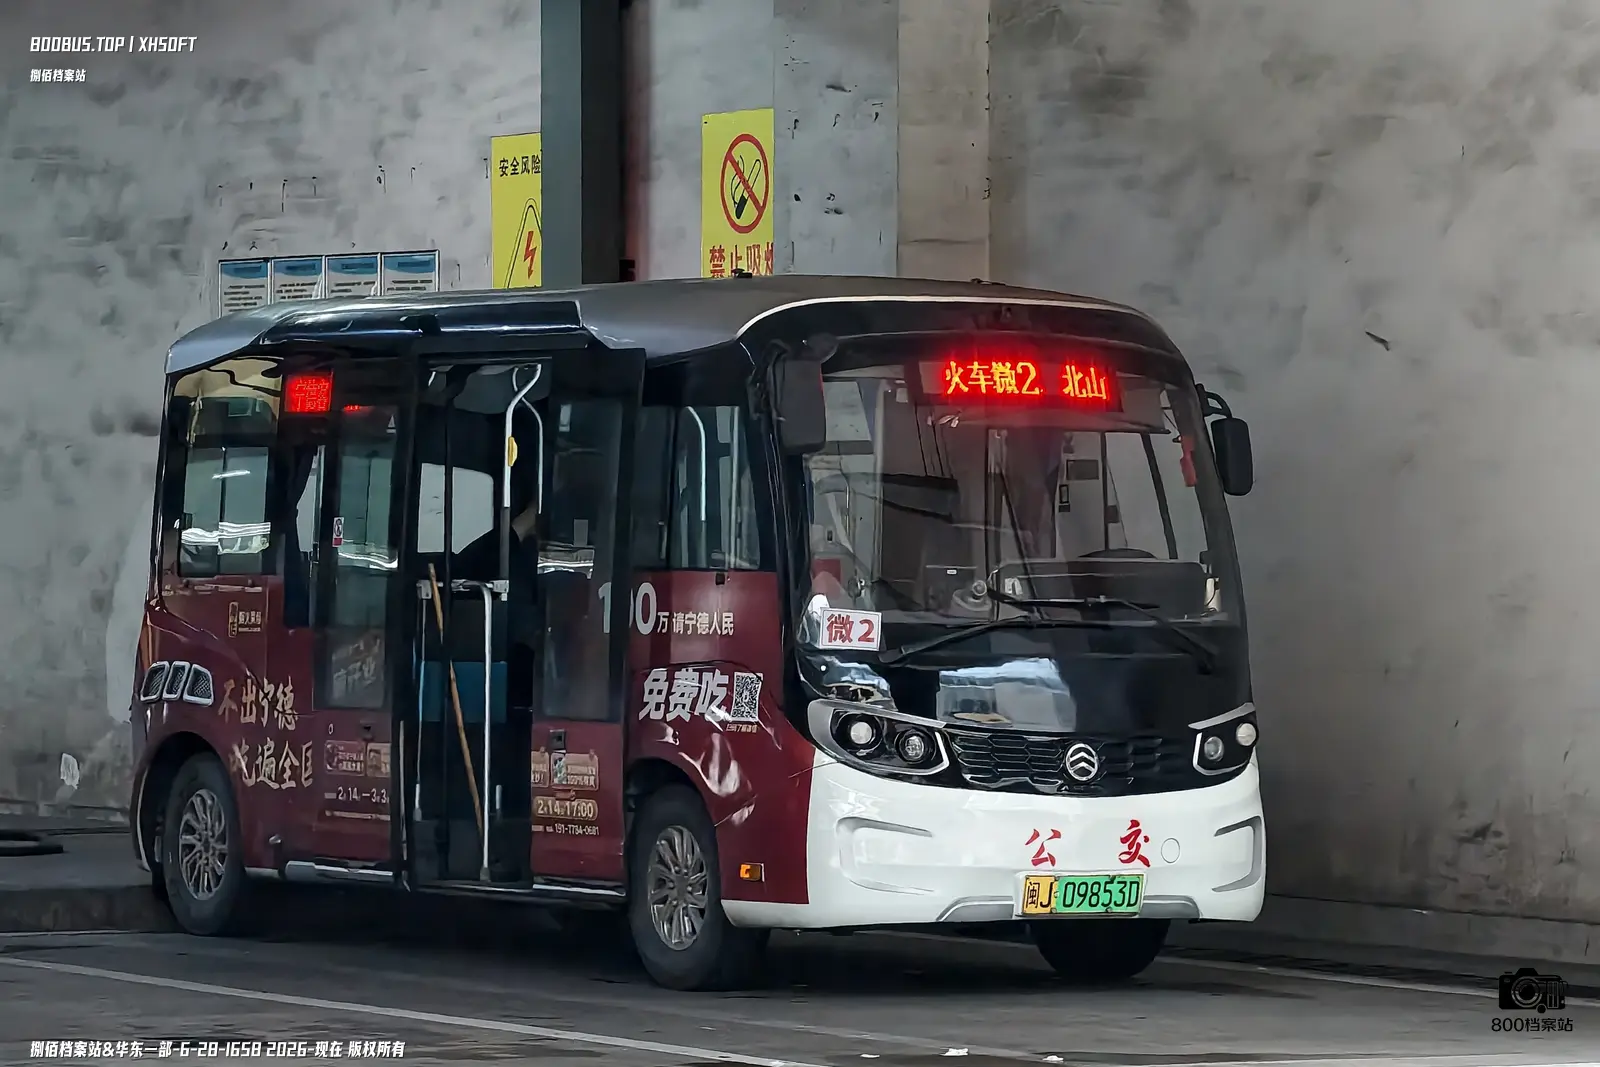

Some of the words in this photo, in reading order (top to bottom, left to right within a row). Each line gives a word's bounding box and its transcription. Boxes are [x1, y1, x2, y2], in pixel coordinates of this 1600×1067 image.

[499, 154, 541, 177] 安全风险
[1061, 364, 1108, 401] 北山
[672, 611, 735, 636] 请宁德人民
[826, 612, 876, 645] 微2
[218, 675, 298, 731] 不出宁德
[638, 668, 733, 724] 免费吃
